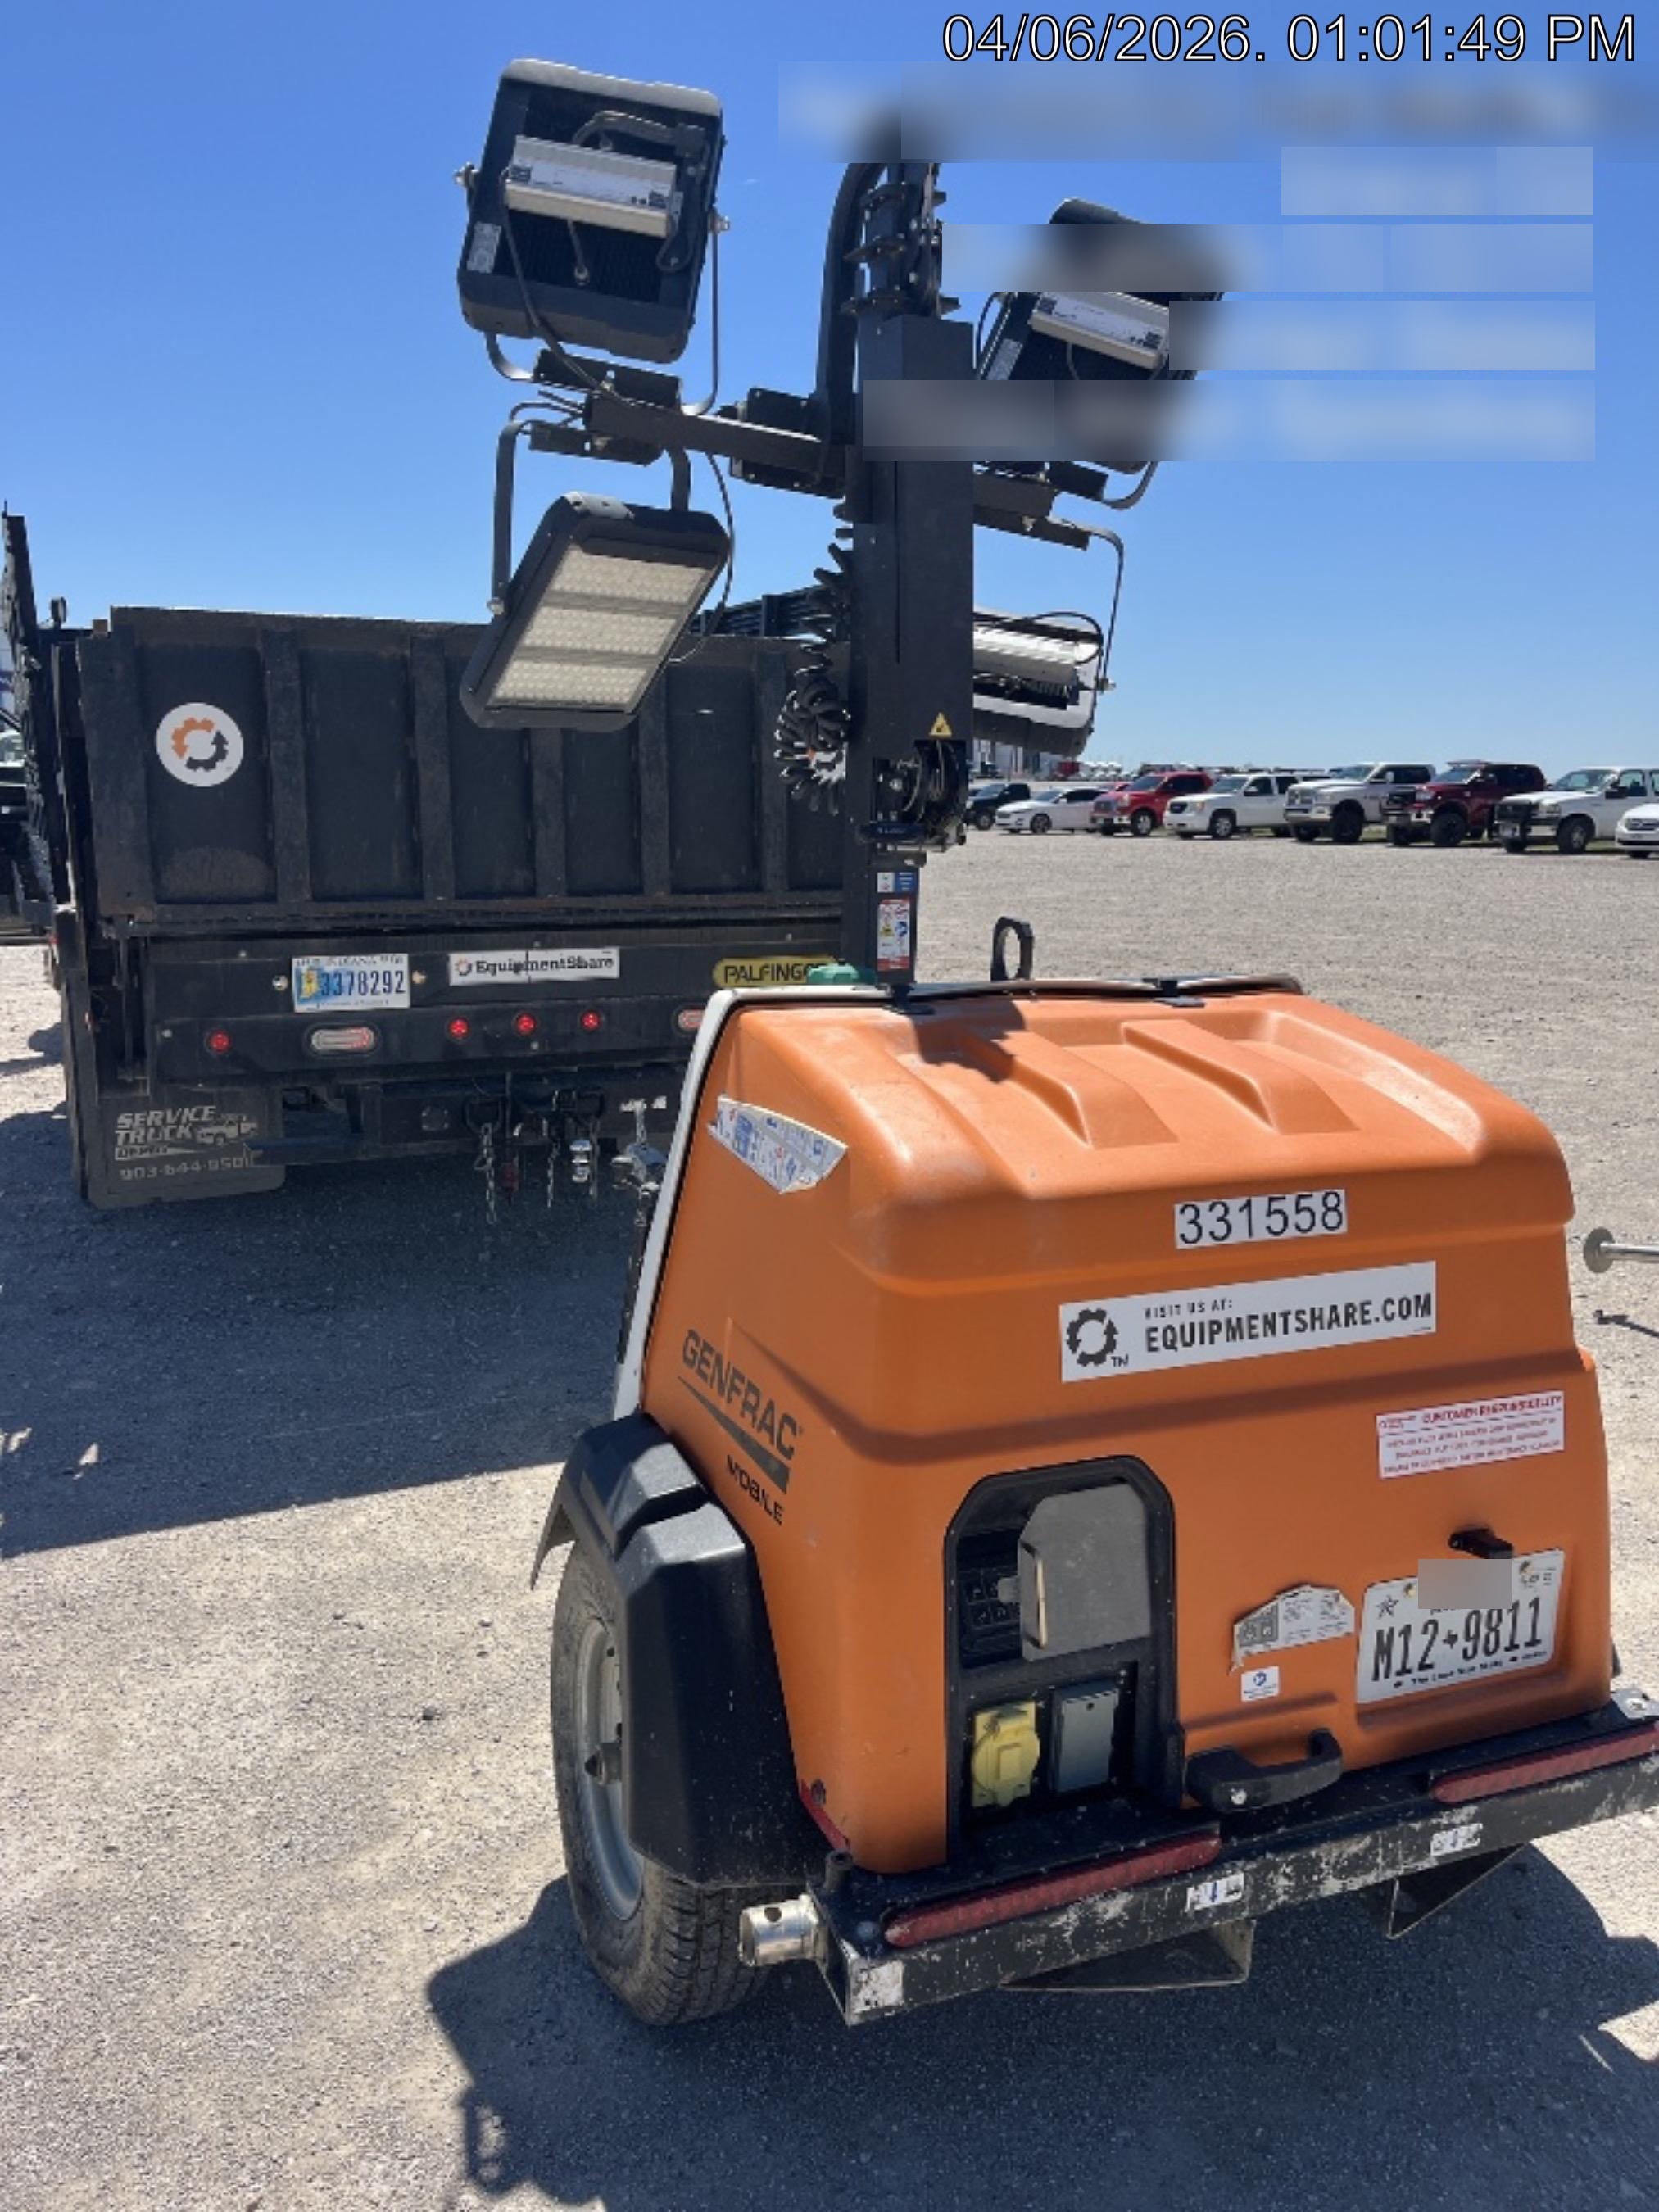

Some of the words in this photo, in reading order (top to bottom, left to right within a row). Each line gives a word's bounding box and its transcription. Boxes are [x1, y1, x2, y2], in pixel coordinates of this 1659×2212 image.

[475, 955, 613, 977] EquipmentShare
[724, 963, 826, 983] PALFING
[320, 969, 406, 997] 3378292
[117, 1106, 216, 1130] SERVICE
[115, 1123, 193, 1146] TRUCK
[1179, 1190, 1344, 1244] 331558
[1145, 1293, 1431, 1353] EQUIPMENTSHARE.COM
